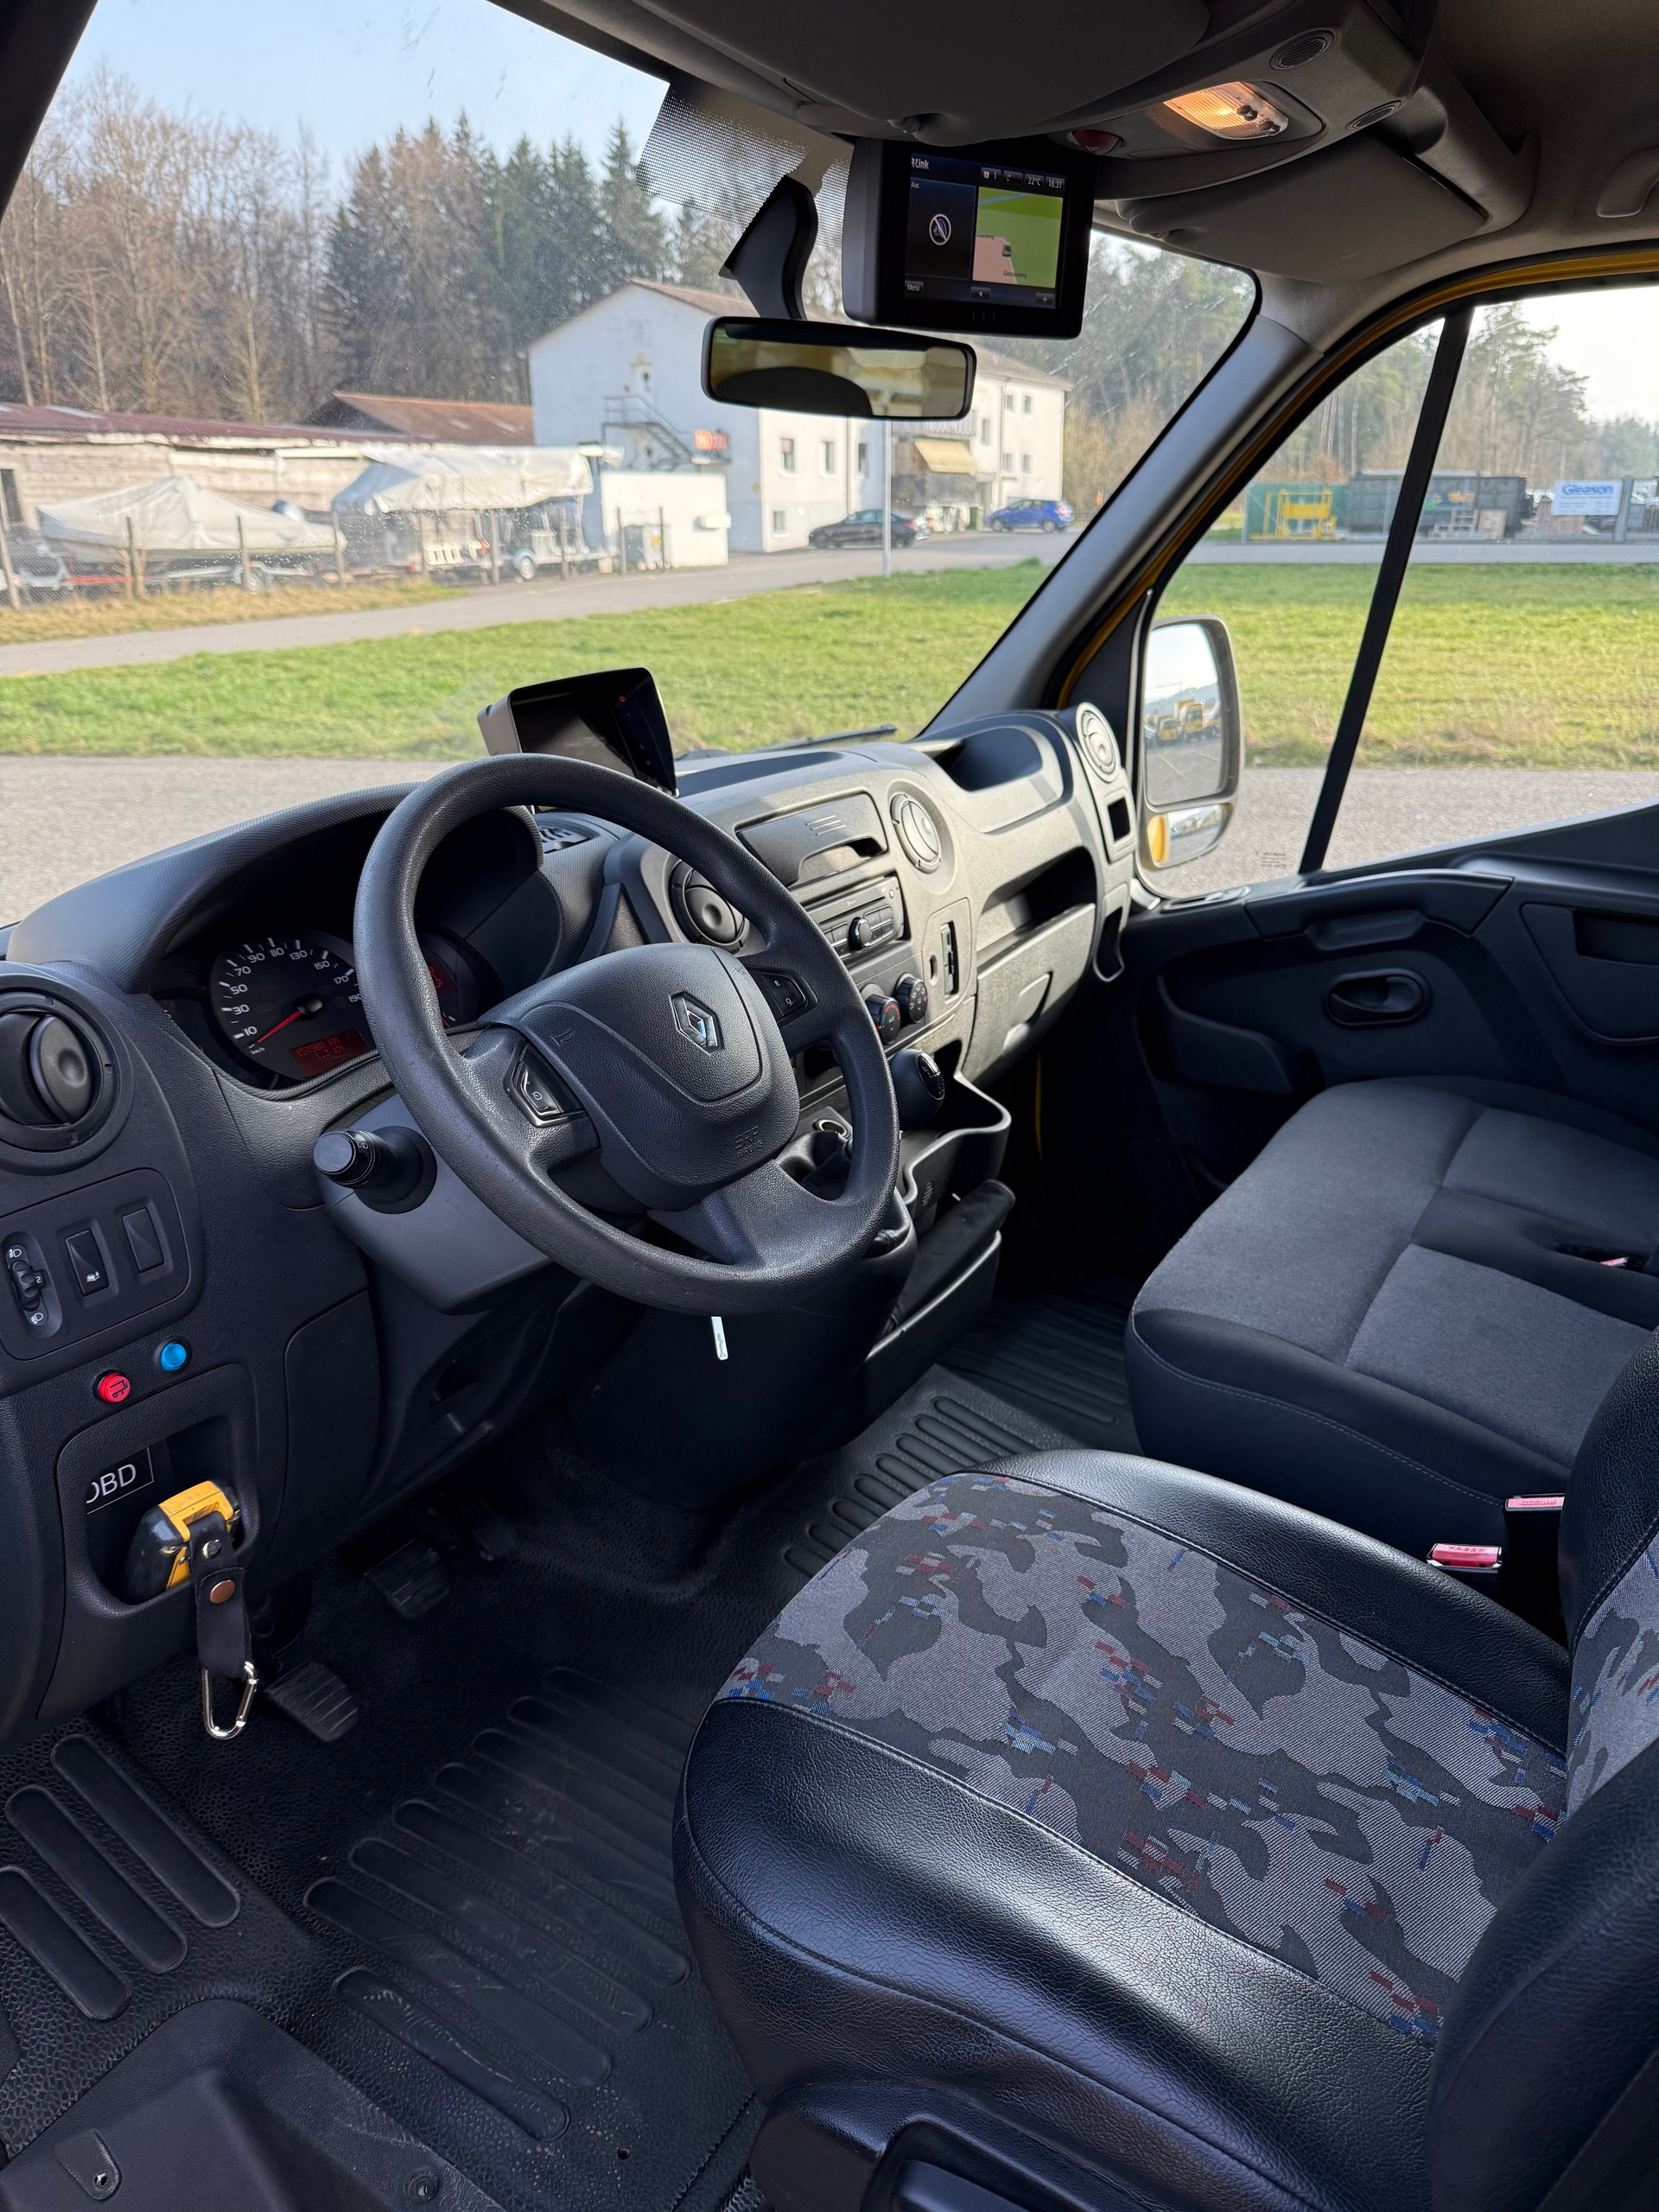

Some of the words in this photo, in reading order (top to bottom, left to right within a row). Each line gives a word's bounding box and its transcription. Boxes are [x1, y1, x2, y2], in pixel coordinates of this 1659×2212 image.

[1027, 176, 1040, 186] 22°C
[1048, 180, 1062, 189] 16:31
[1561, 484, 1614, 495] Gleason
[270, 947, 285, 957] 110
[289, 950, 308, 961] 130
[248, 952, 265, 963] 90
[314, 960, 331, 970] 150
[234, 966, 251, 977] 70
[334, 975, 349, 985] 170
[230, 983, 248, 995] 50
[232, 1004, 250, 1015] 30
[244, 1026, 257, 1036] 10
[35, 1275, 41, 1284] 2
